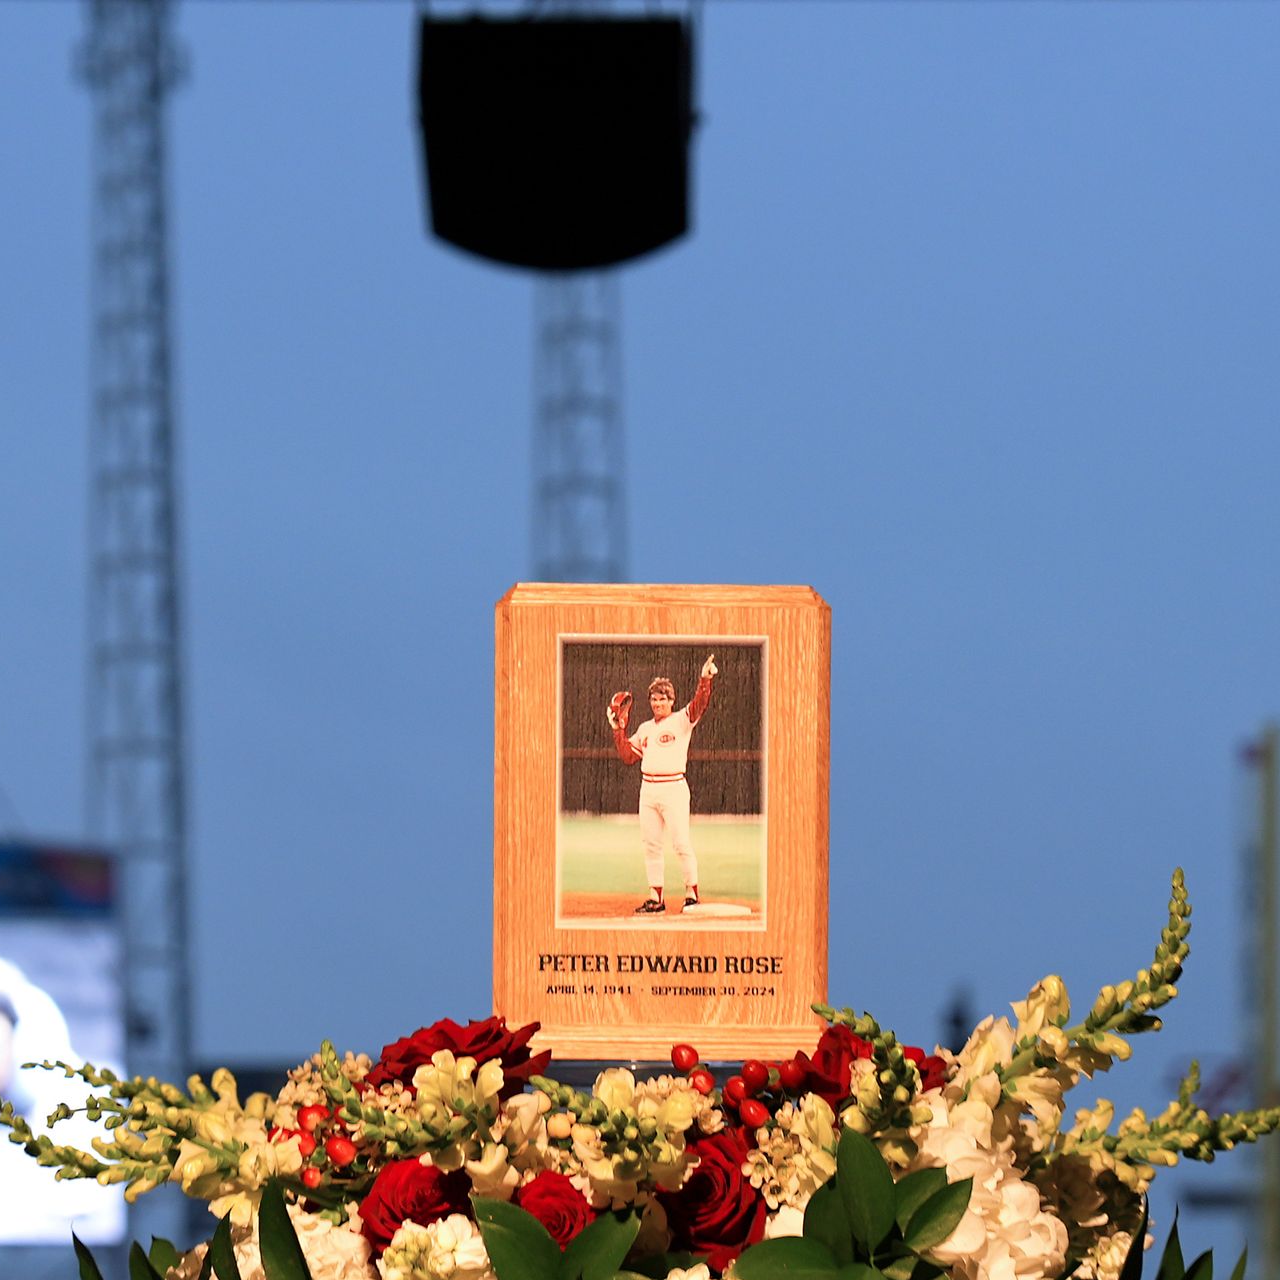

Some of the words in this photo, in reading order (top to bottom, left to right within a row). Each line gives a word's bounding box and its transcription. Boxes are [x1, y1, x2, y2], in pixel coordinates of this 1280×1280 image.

[538, 954, 609, 972] PETER
[616, 955, 717, 973] EDWARD
[725, 956, 783, 974] ROSE
[603, 985, 631, 995] 1941
[651, 986, 716, 996] SEPTEMBER
[743, 986, 775, 996] 2024
